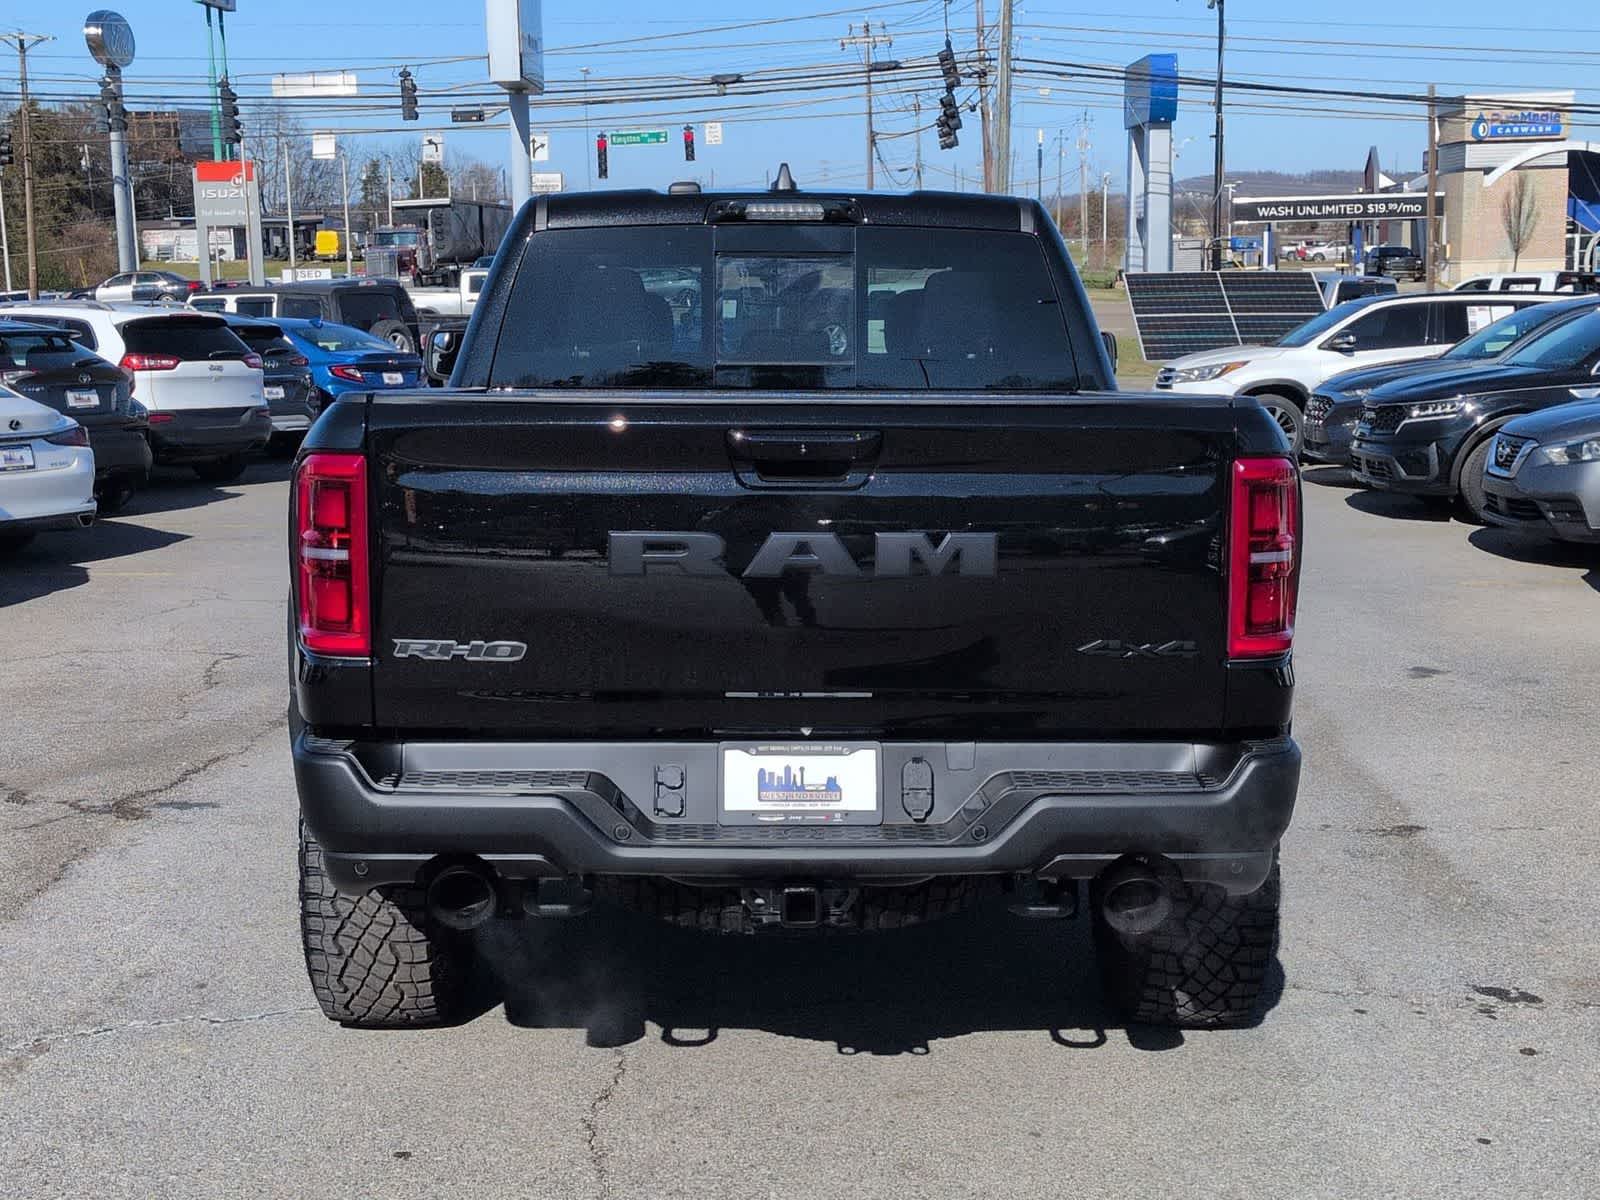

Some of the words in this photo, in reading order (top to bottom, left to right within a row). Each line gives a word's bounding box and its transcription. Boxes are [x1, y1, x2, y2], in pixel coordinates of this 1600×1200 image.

[1257, 206, 1294, 217] WASH
[1297, 203, 1363, 216] UNLIMITED
[608, 530, 998, 578] RAM
[392, 638, 527, 661] RHO
